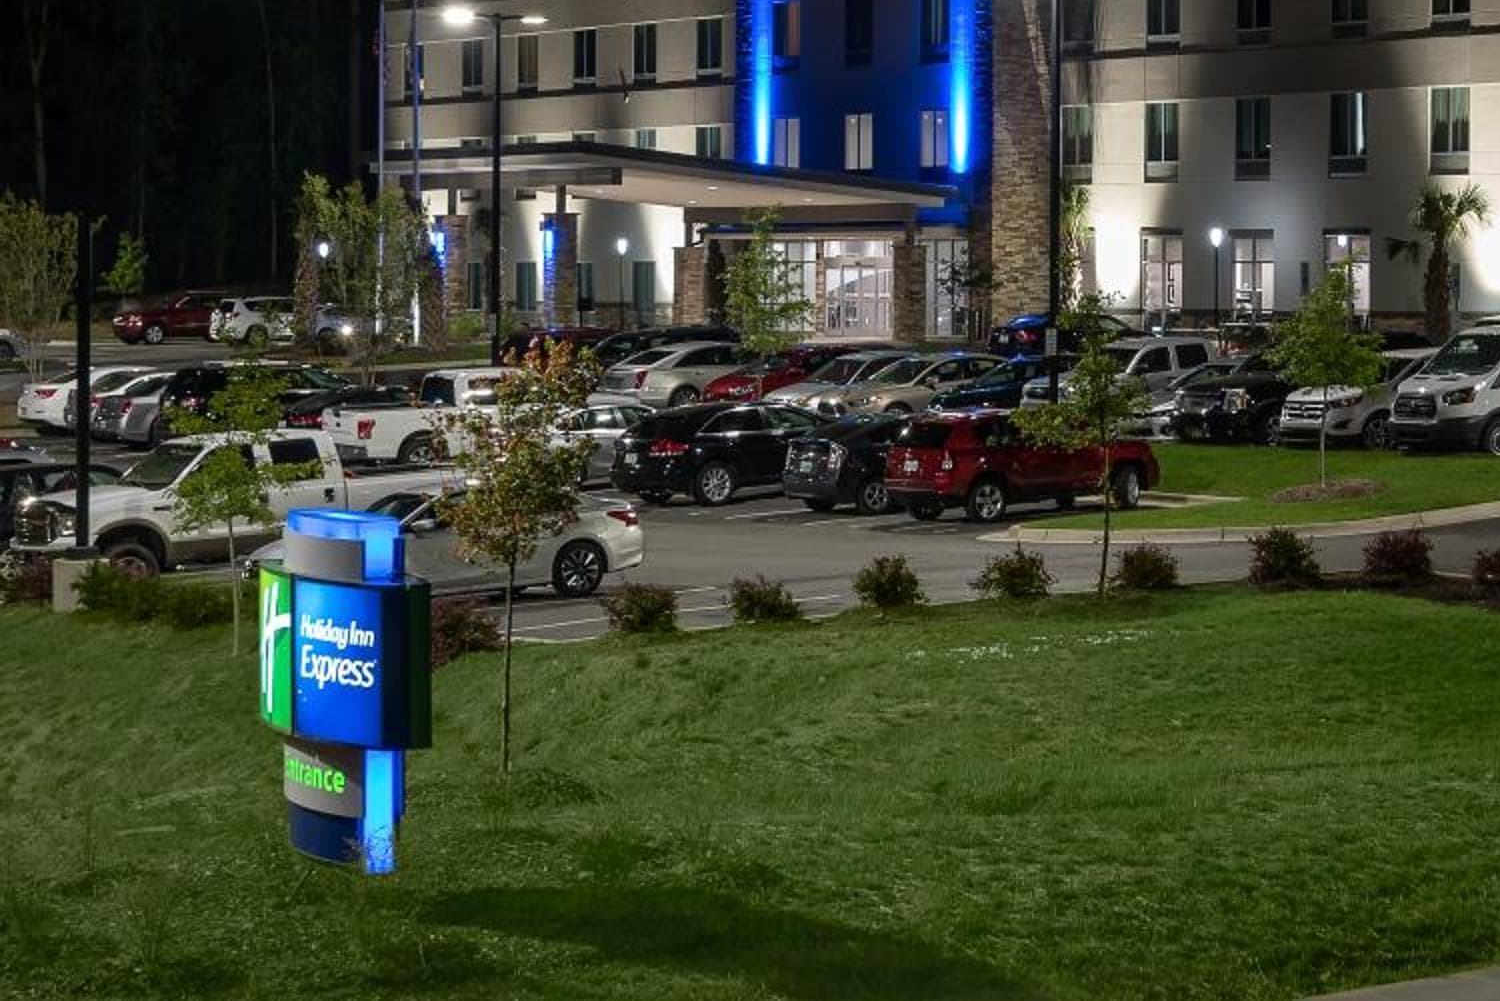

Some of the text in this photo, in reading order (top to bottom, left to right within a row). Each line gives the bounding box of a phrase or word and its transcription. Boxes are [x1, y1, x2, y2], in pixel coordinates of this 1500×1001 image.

[300, 615, 375, 650] Holiday Inn
[301, 644, 375, 689] Express
